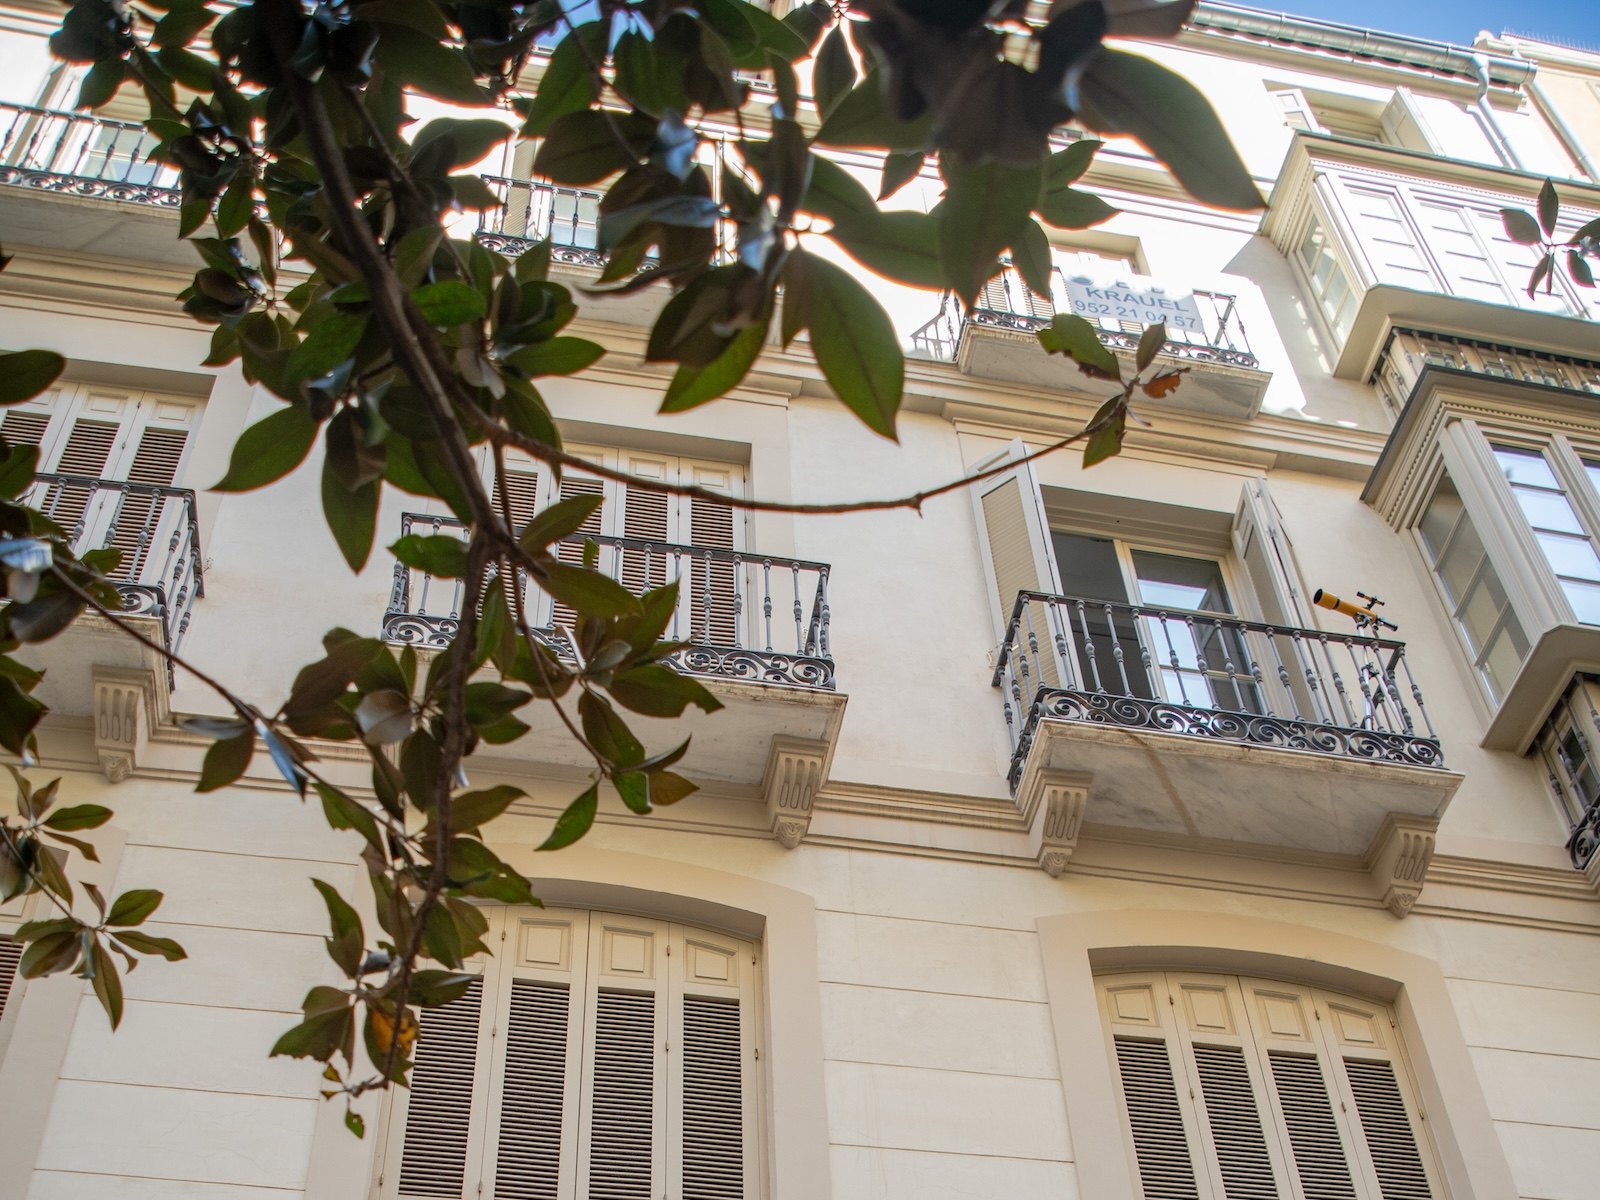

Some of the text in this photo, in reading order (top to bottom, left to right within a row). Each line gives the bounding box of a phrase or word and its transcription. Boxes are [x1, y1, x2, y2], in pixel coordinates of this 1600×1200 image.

[1085, 287, 1189, 312] KRAUEL
[1074, 299, 1112, 315] 952
[1116, 306, 1138, 319] 21
[1174, 315, 1196, 328] 57
